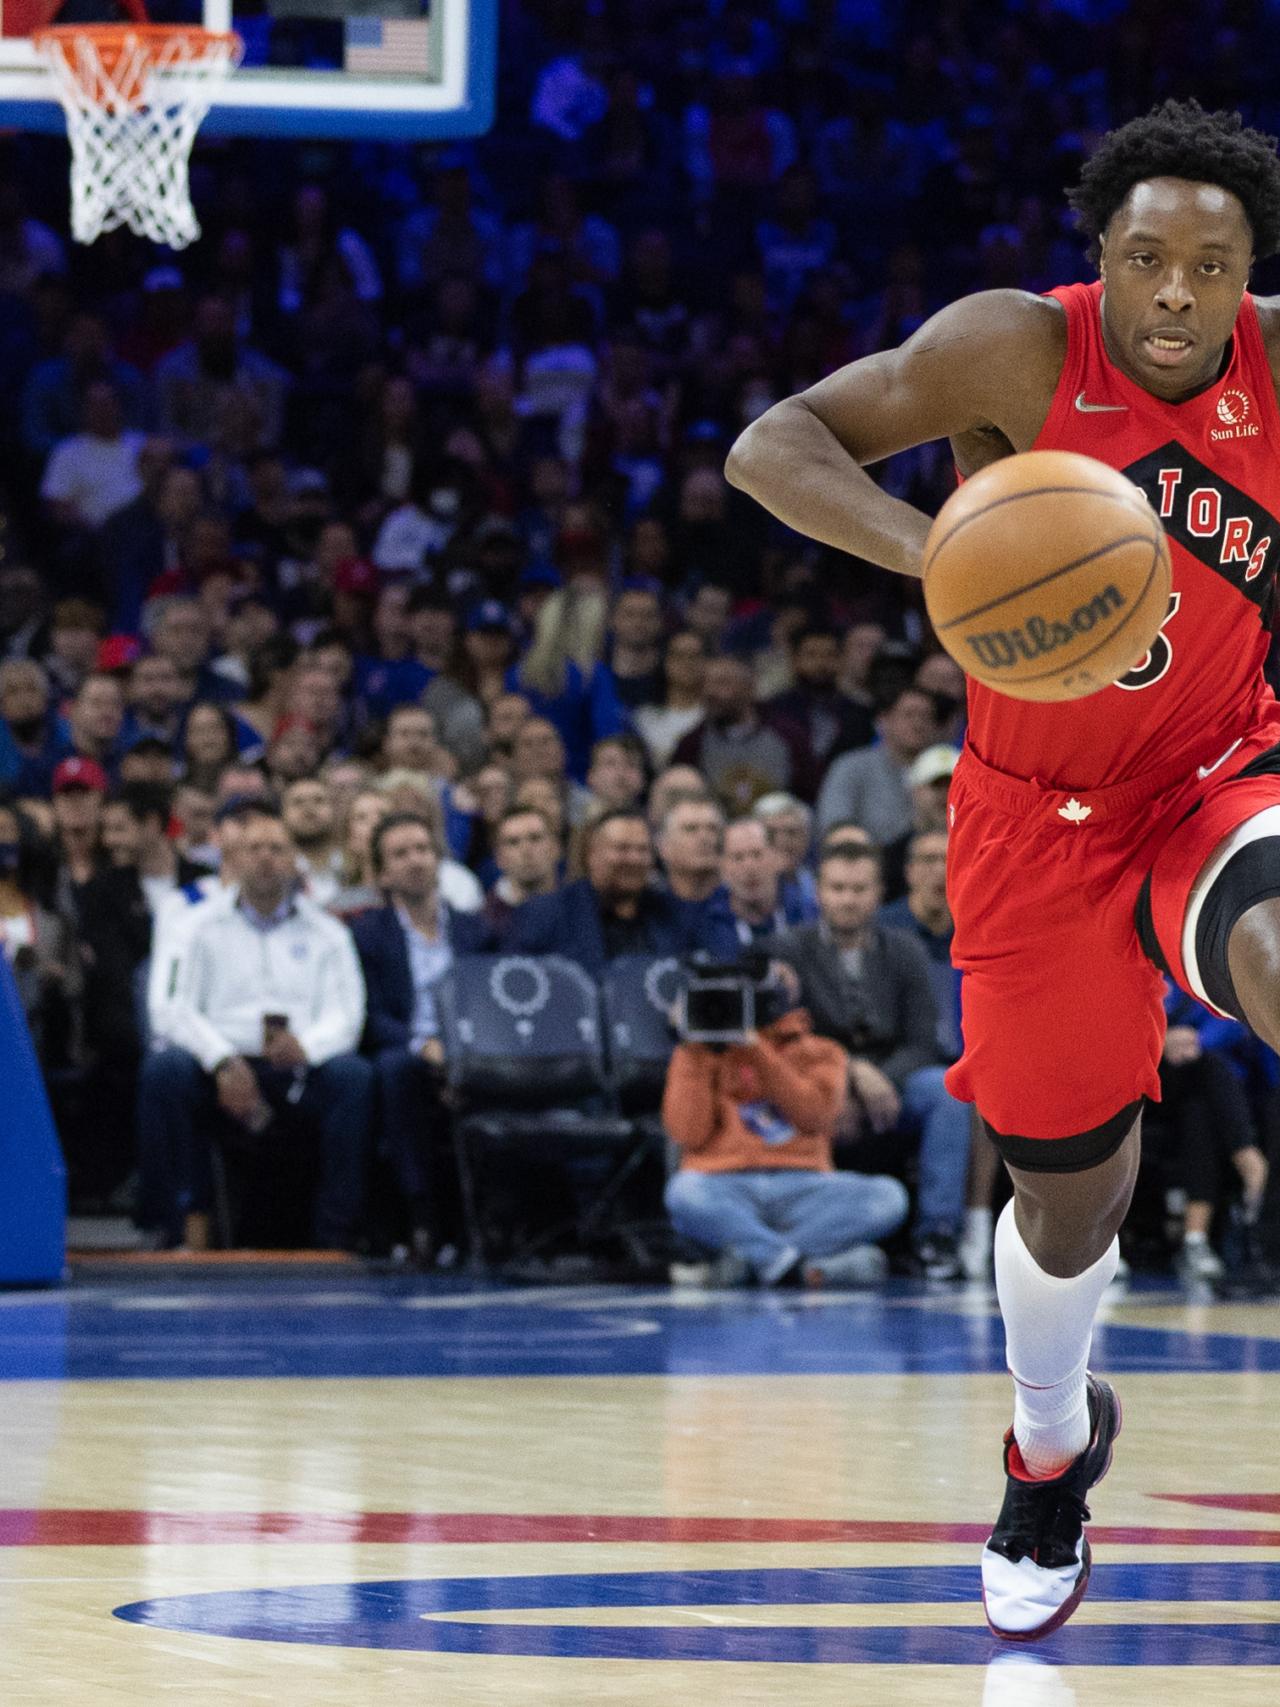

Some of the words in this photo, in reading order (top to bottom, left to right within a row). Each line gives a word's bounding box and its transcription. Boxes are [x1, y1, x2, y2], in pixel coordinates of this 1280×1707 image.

[1210, 428, 1233, 440] Sun
[1236, 423, 1259, 437] Life
[1137, 467, 1271, 582] TORS
[966, 583, 1127, 669] Wilson
